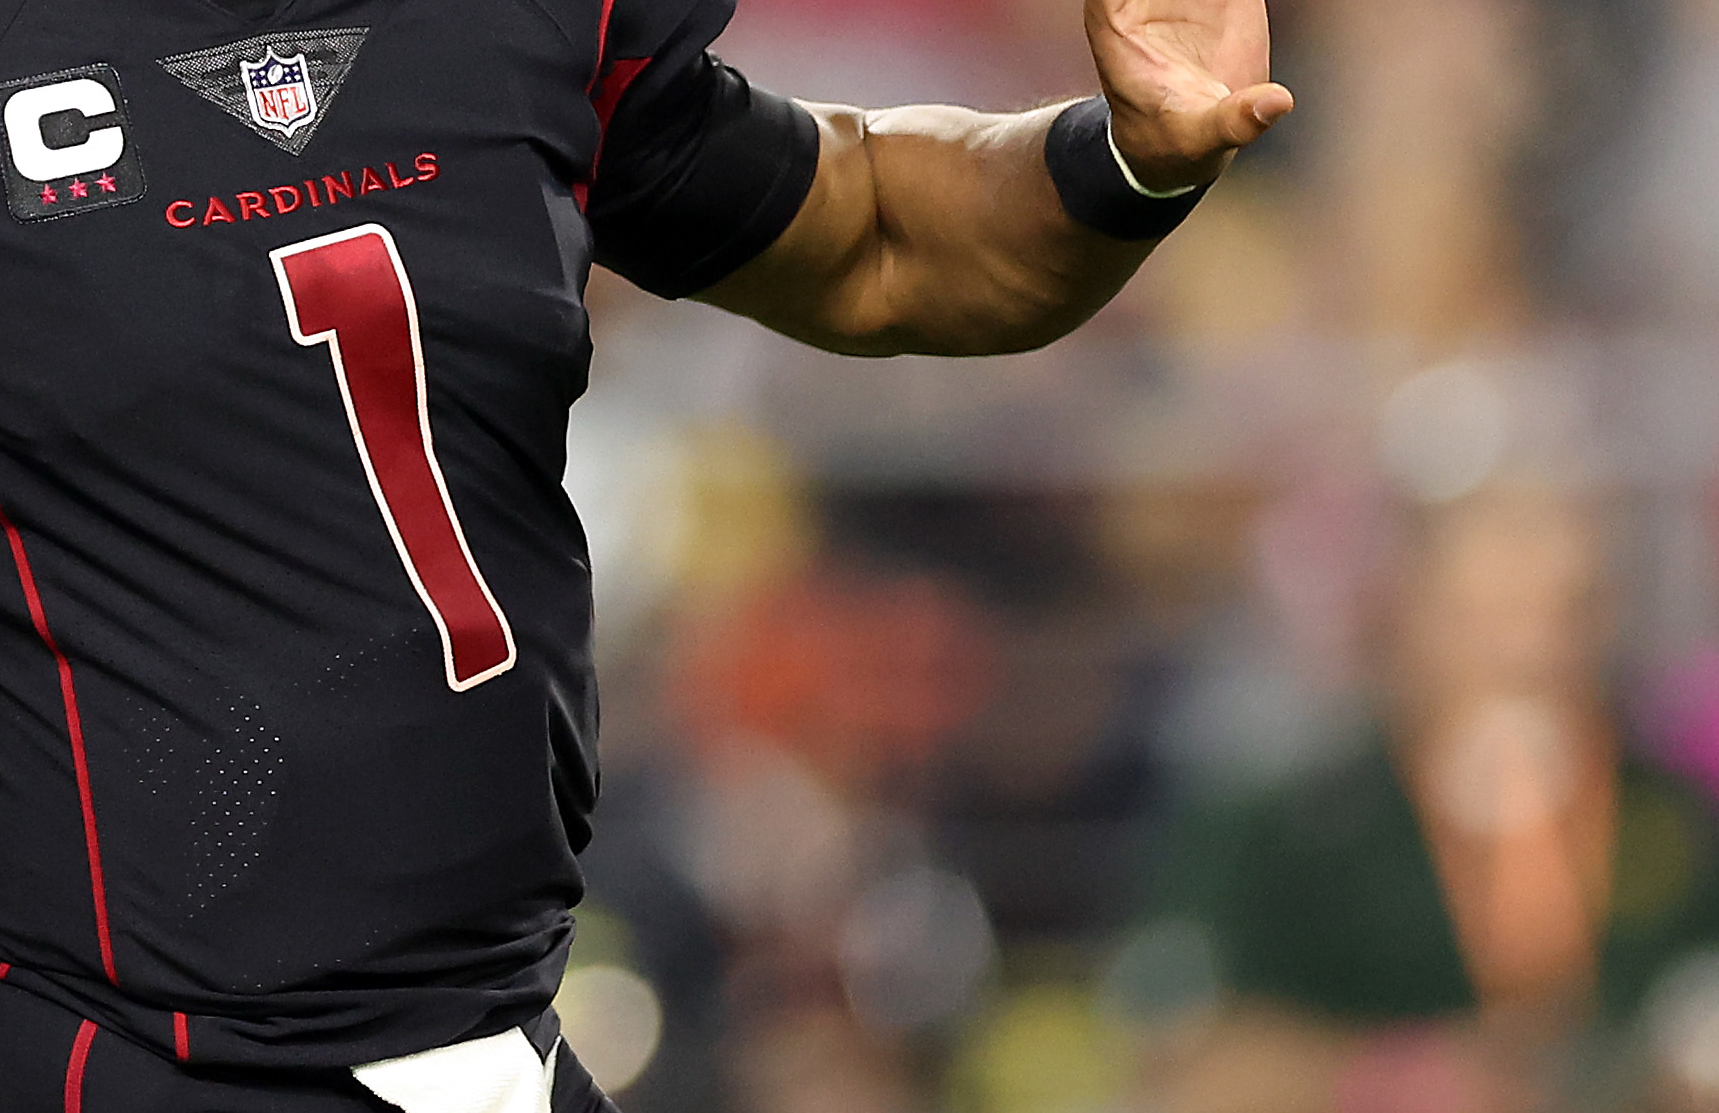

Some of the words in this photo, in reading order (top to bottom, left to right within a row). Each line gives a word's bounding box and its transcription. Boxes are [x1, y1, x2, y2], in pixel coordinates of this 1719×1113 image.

[4, 78, 124, 182] C
[258, 86, 307, 120] NFL
[165, 152, 441, 228] CARDINALS
[269, 223, 517, 692] 1
